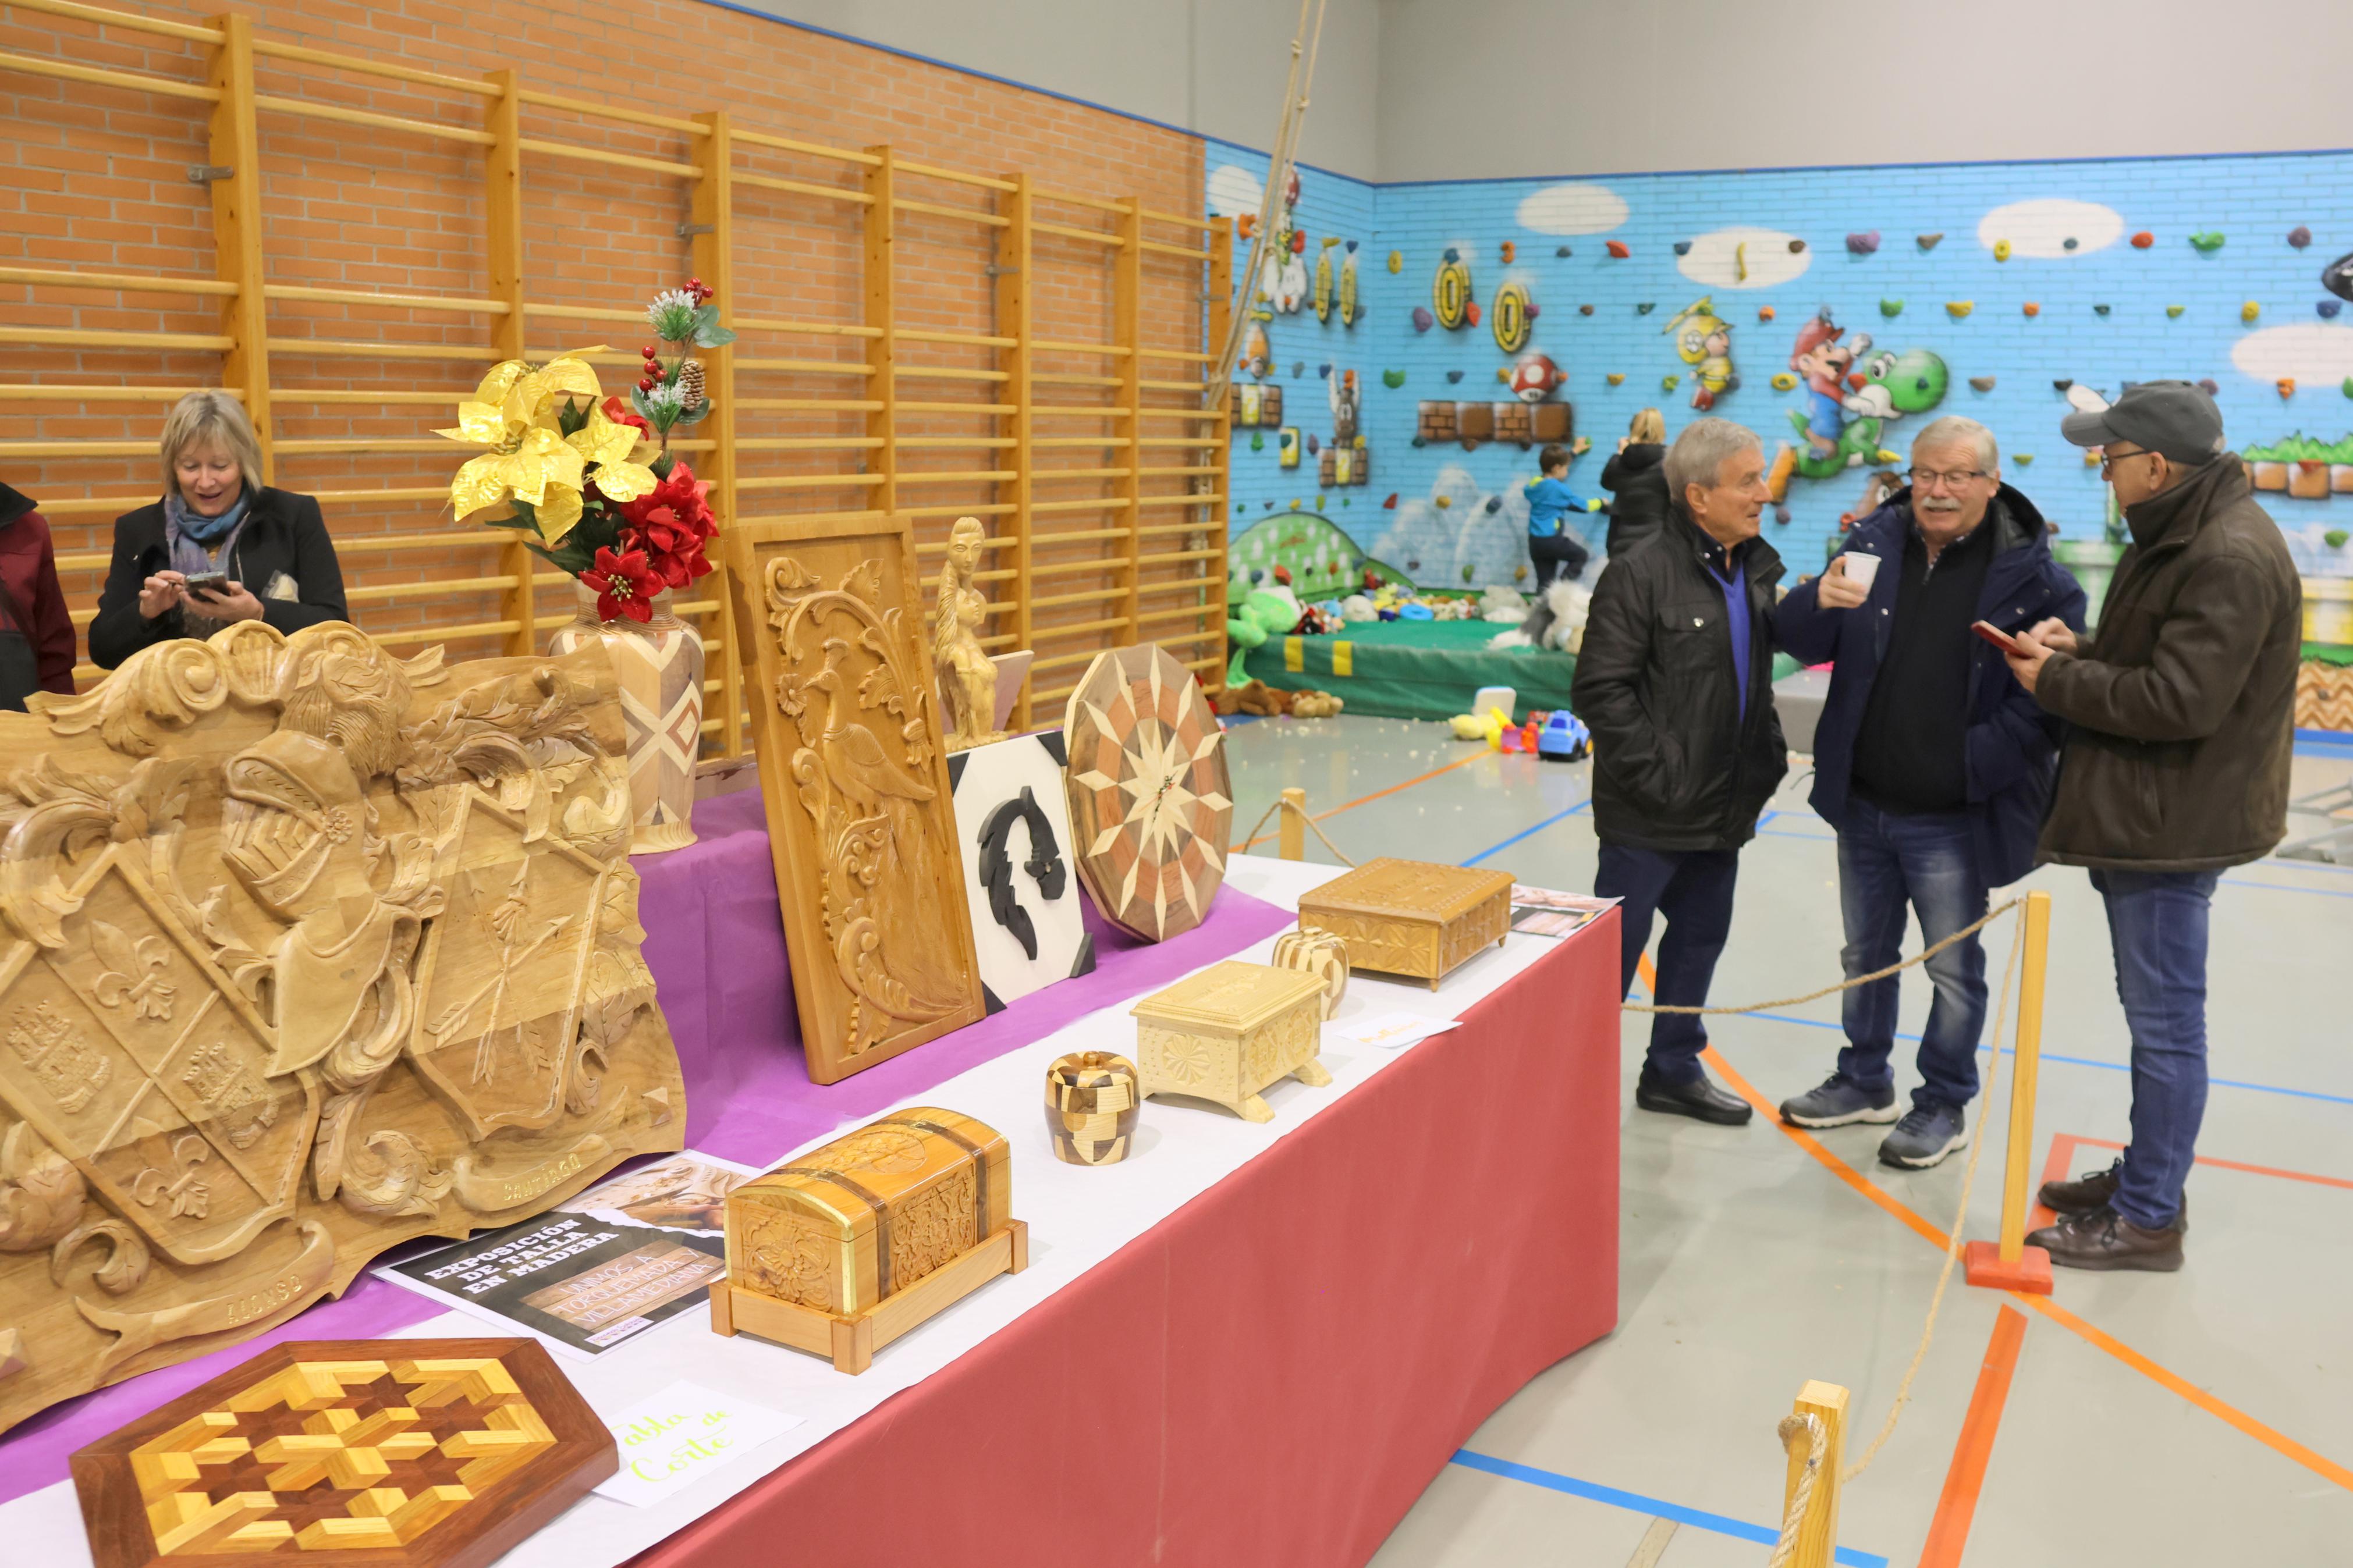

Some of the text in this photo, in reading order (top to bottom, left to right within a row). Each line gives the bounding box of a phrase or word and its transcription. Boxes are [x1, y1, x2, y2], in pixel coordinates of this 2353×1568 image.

[424, 1218, 582, 1280] EXPOSICIÓN
[457, 1230, 590, 1282] DE TALLA
[462, 1231, 620, 1295] EN MADERA
[559, 1254, 659, 1295] UNIMOS A
[551, 1249, 700, 1314] TORQUEMADA Y
[573, 1262, 715, 1323] VILLAMEDIANA
[610, 1410, 733, 1446] abla de
[630, 1425, 734, 1482] Corte
